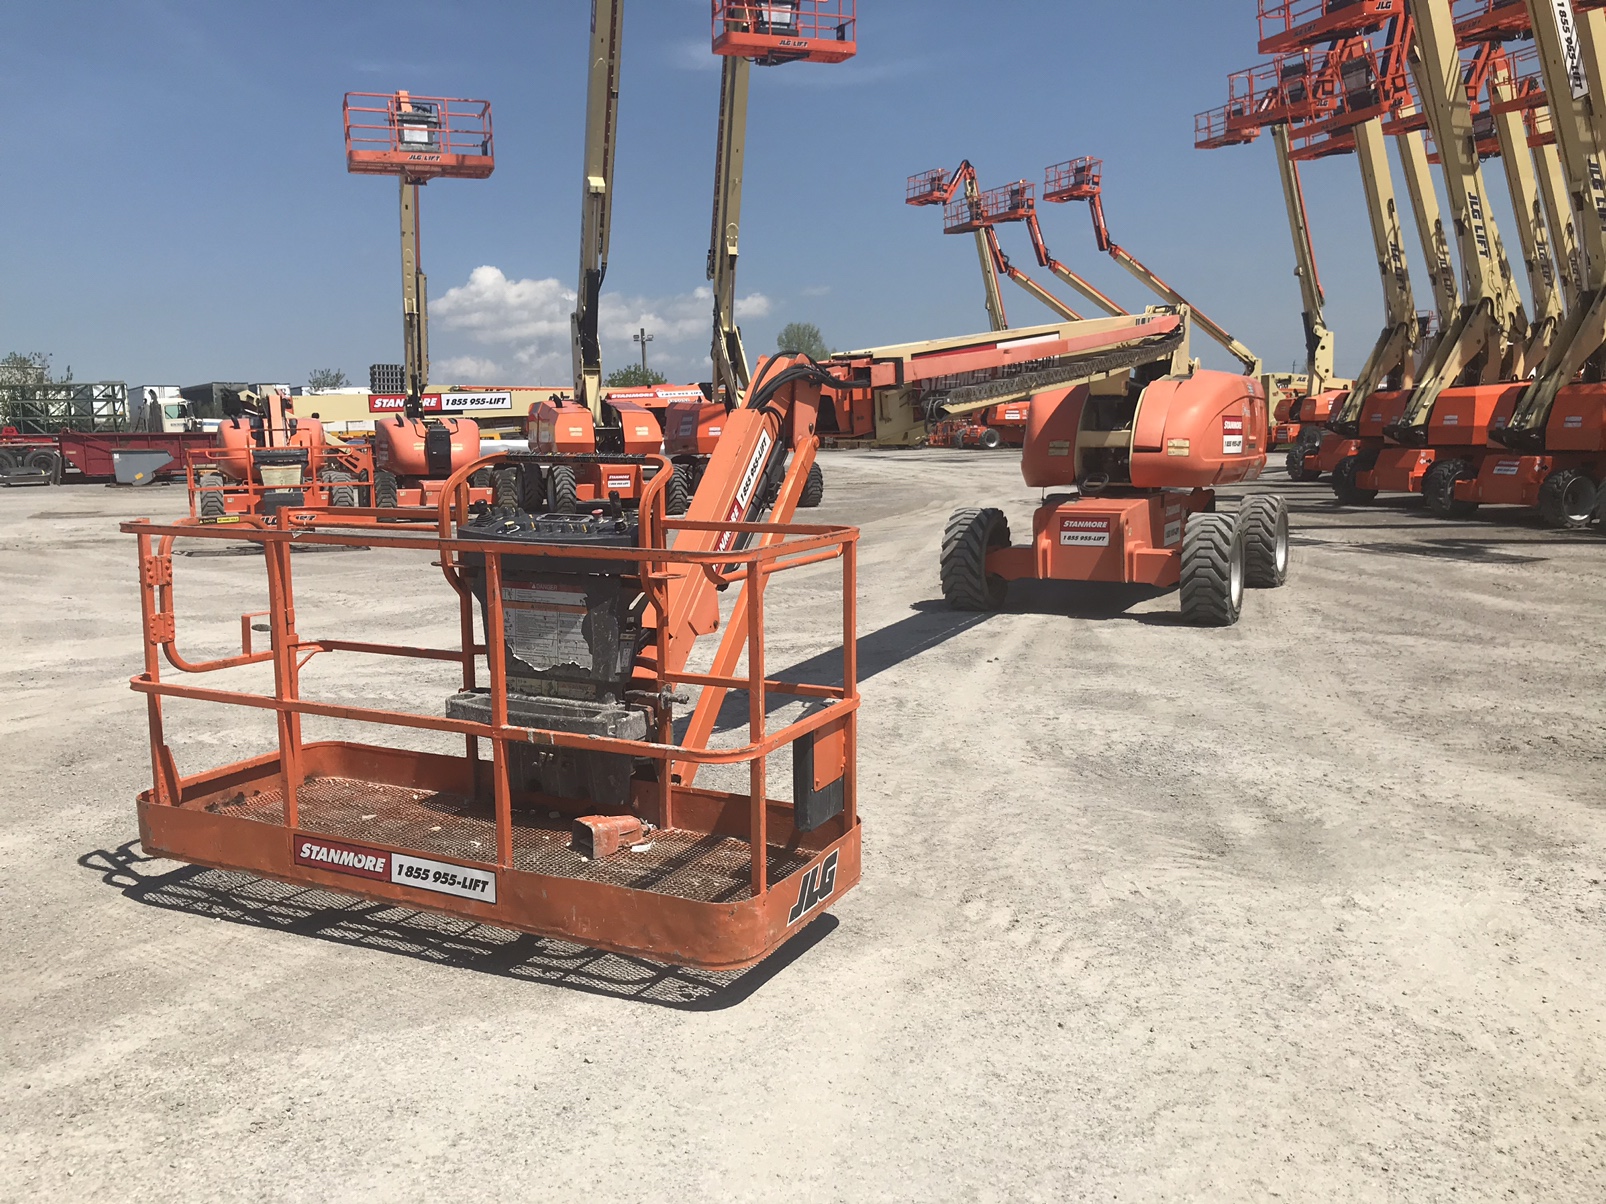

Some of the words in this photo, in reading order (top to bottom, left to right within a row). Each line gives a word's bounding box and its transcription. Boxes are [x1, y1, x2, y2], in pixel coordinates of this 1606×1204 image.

[1376, 1, 1391, 10] JLG
[1559, 10, 1571, 34] 855
[1565, 36, 1583, 90] 955-LIFT
[1588, 158, 1604, 190] JLG
[1467, 191, 1481, 220] JLG
[1474, 225, 1488, 258] LIFT
[374, 398, 438, 408] STANRE
[451, 398, 467, 406] 855
[470, 397, 507, 406] 955-LIFT
[742, 475, 752, 497] 855
[750, 437, 767, 477] 955-LIFT
[1063, 520, 1108, 528] STANMORE
[300, 843, 386, 873] STANMORE
[397, 864, 404, 876] 1
[404, 866, 430, 881] 855
[432, 870, 489, 893] 955-LIFT
[787, 848, 839, 927] JLG
